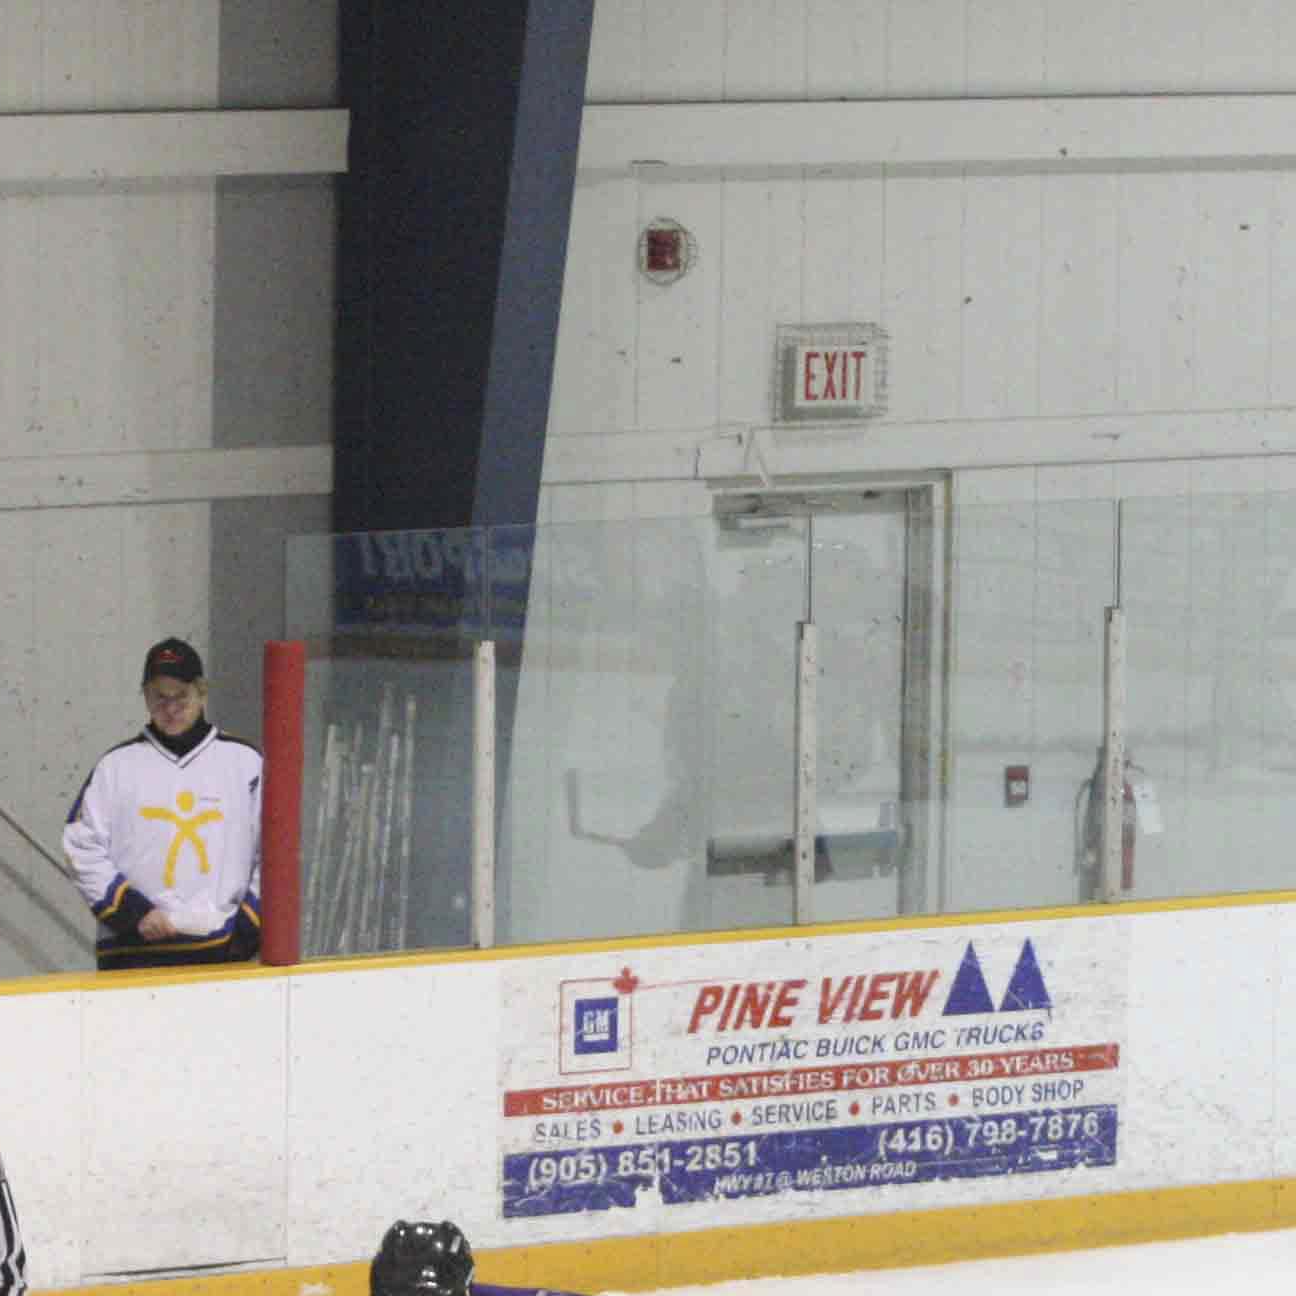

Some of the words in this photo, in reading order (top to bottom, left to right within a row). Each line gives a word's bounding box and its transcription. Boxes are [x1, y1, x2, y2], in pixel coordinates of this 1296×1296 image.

[804, 352, 866, 400] EXIT
[583, 1009, 609, 1041] GM
[686, 979, 807, 1035] PINE
[817, 968, 940, 1023] VIEW
[706, 1036, 807, 1066] PONTIAC
[816, 1033, 886, 1058] BUICK
[894, 1030, 945, 1051] GMC
[956, 1021, 1046, 1047] TRUCKS
[543, 1083, 644, 1109] SERVICE
[656, 1079, 712, 1102] THAT
[719, 1070, 834, 1097] SATISFIES
[842, 1066, 890, 1088] FOR
[896, 1060, 961, 1083] OVER
[966, 1056, 994, 1077] 30
[1002, 1051, 1074, 1074] YEARS
[535, 1118, 602, 1144] SALES
[635, 1109, 722, 1136] LEASING
[752, 1099, 838, 1126] SERVICE
[872, 1091, 937, 1116] PARTS
[971, 1084, 1025, 1108] BODY
[1032, 1079, 1085, 1102] SHOP
[878, 1124, 953, 1156] (416)
[964, 1111, 1100, 1148] 798-7876
[528, 1153, 604, 1190] (905)
[618, 1142, 757, 1175] 851-2851
[869, 1160, 918, 1181] ROAD
